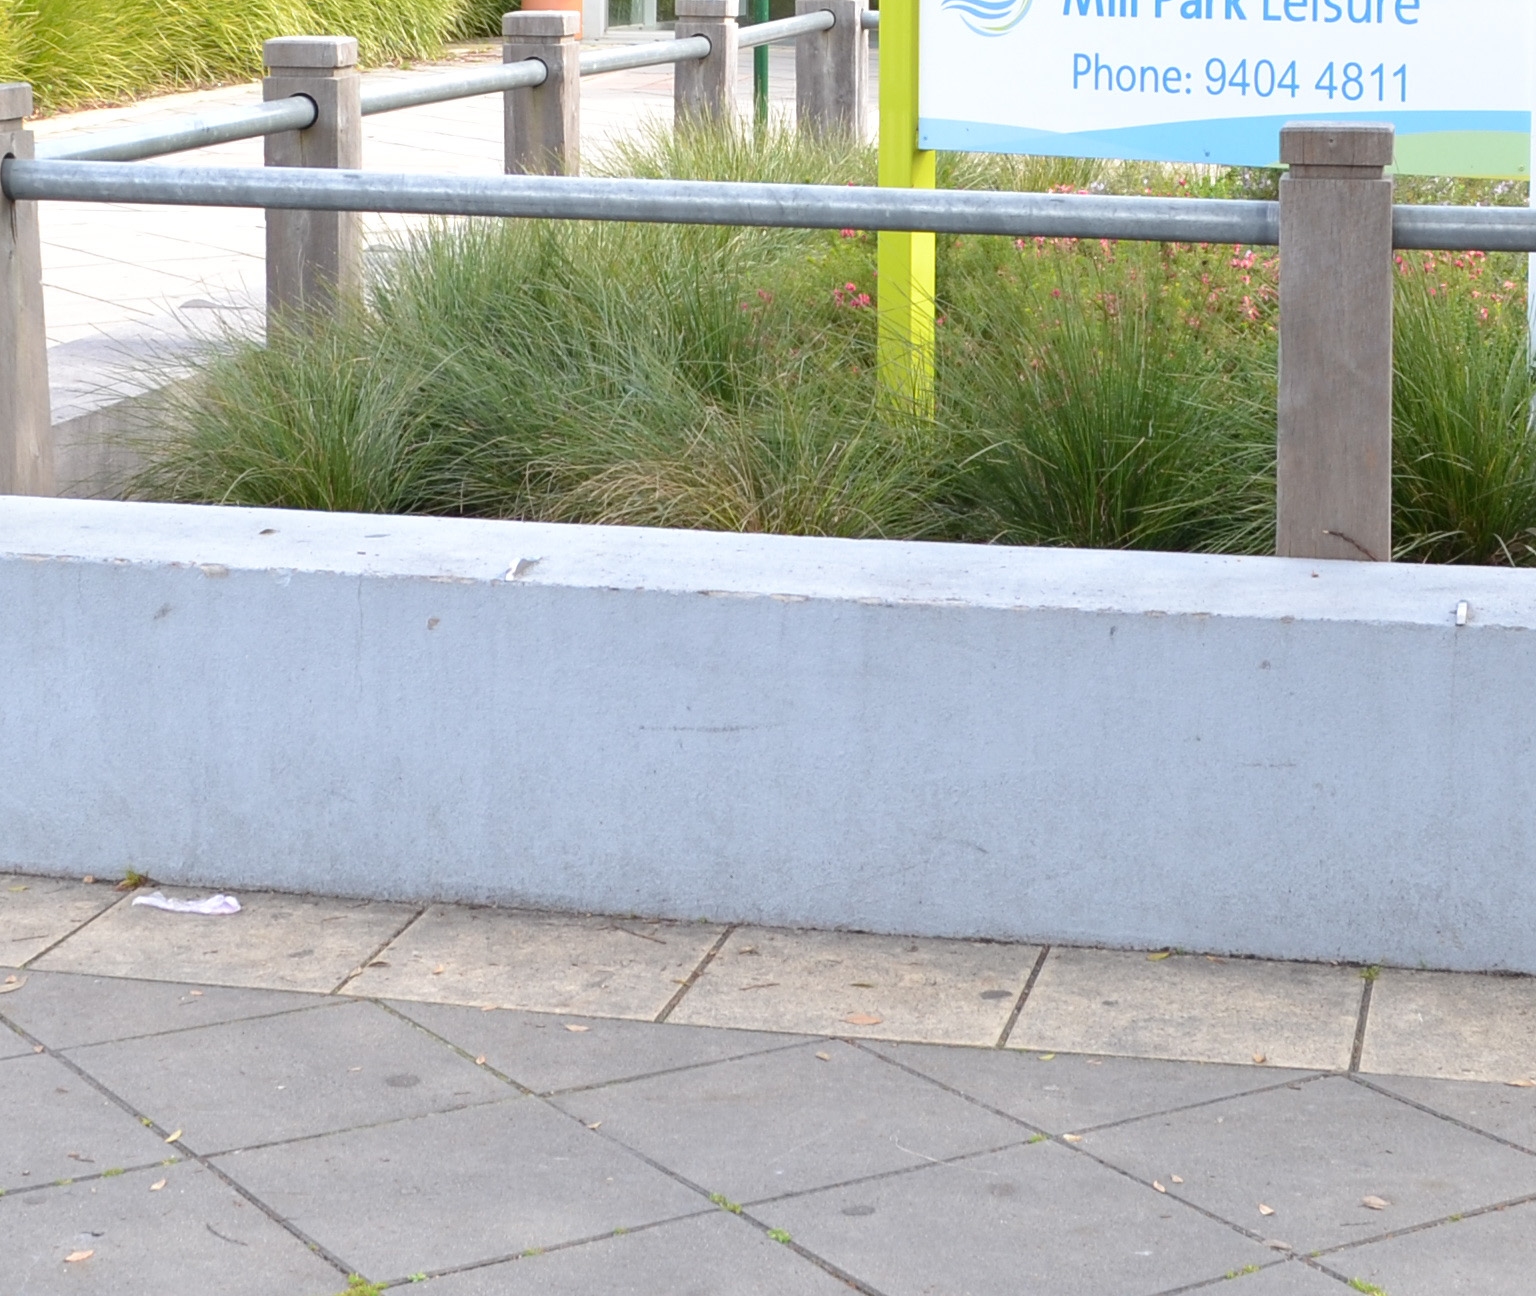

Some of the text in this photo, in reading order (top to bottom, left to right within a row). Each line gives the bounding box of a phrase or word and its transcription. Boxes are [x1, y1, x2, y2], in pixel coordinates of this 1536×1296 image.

[1073, 53, 1407, 102] Phone: 9404 4811
